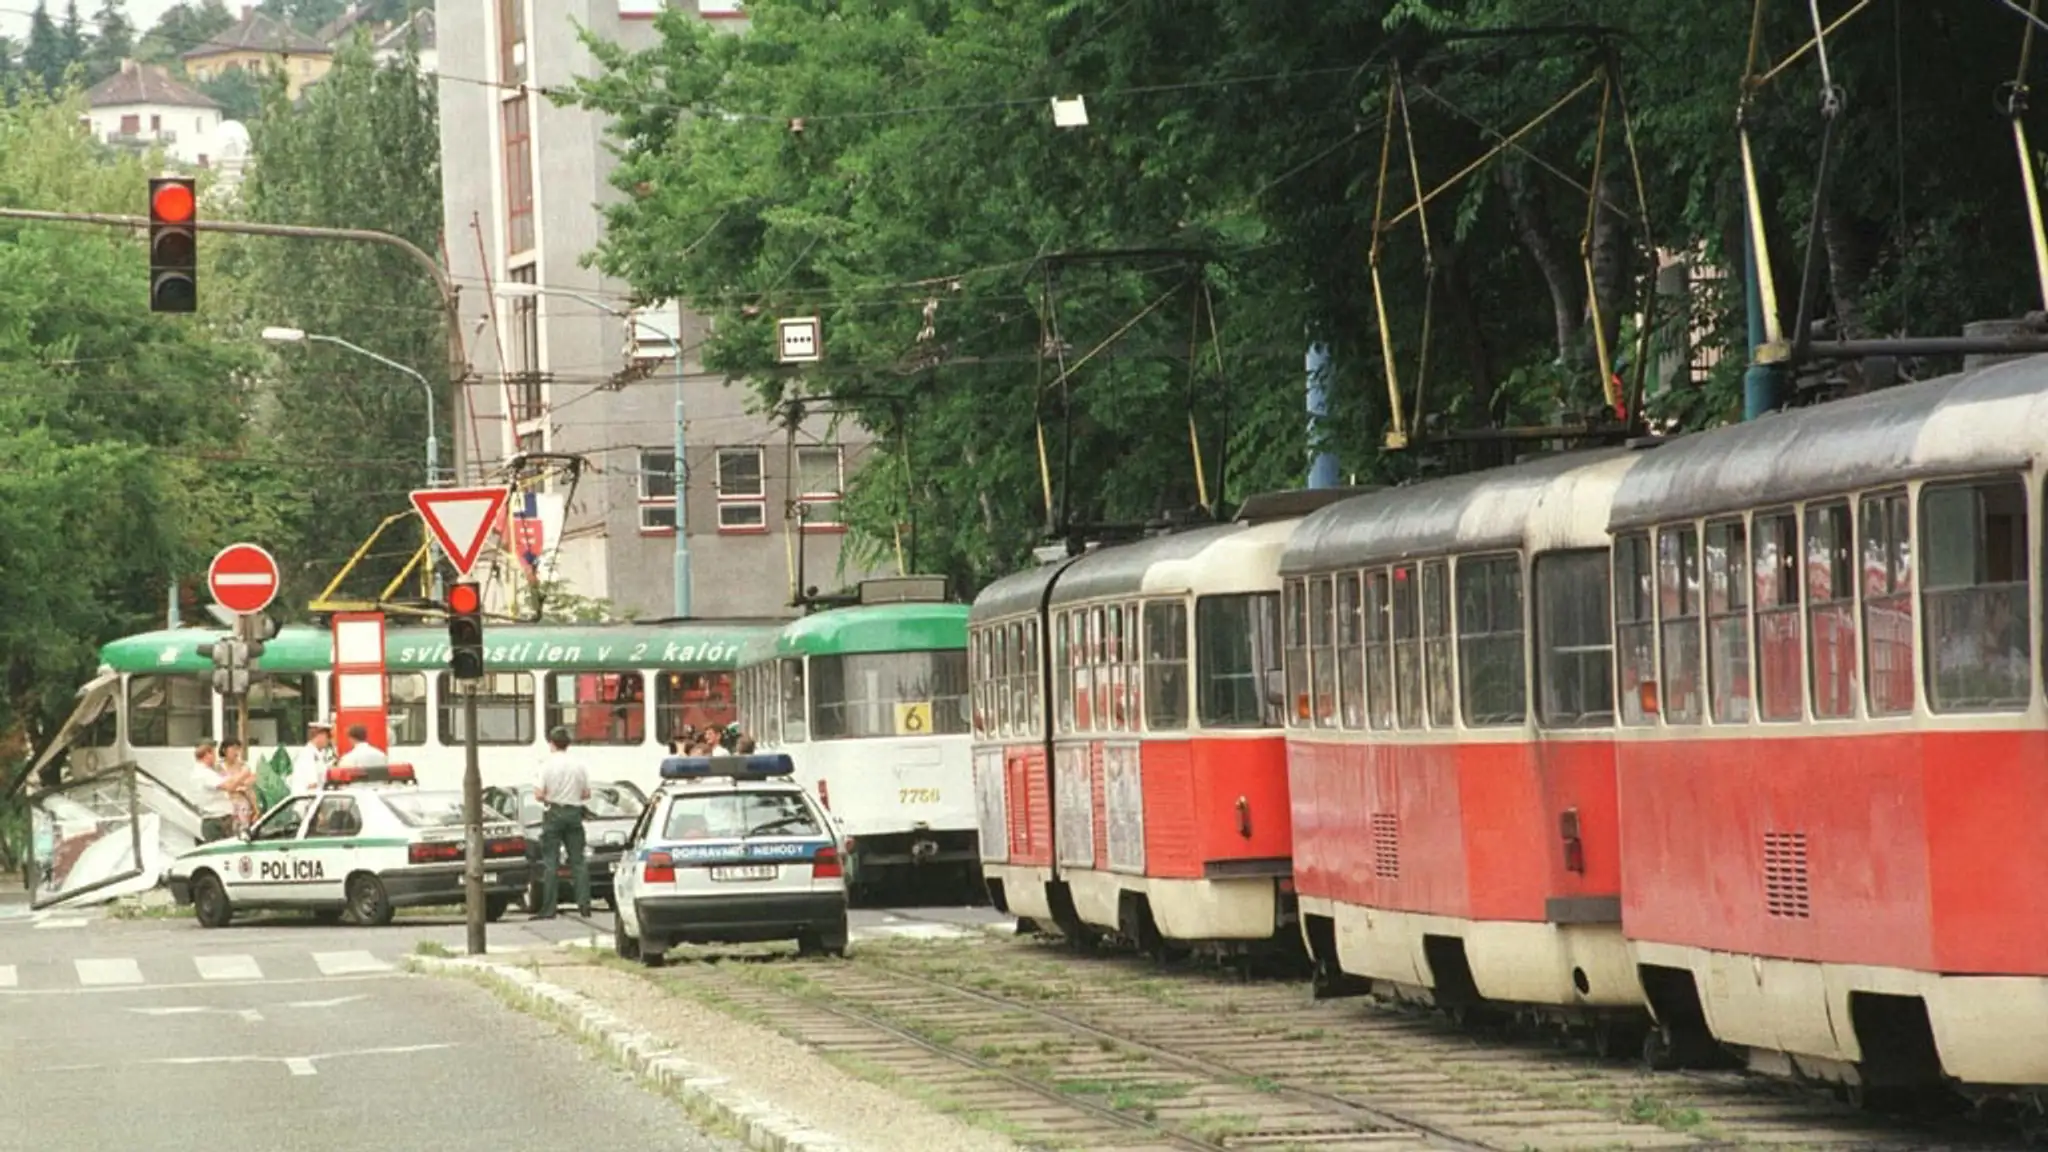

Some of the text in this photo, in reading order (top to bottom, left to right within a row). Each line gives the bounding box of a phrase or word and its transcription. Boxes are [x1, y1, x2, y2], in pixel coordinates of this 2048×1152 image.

[598, 644, 612, 662] v
[629, 642, 648, 662] 2
[662, 639, 747, 663] kalór
[905, 706, 923, 731] 6
